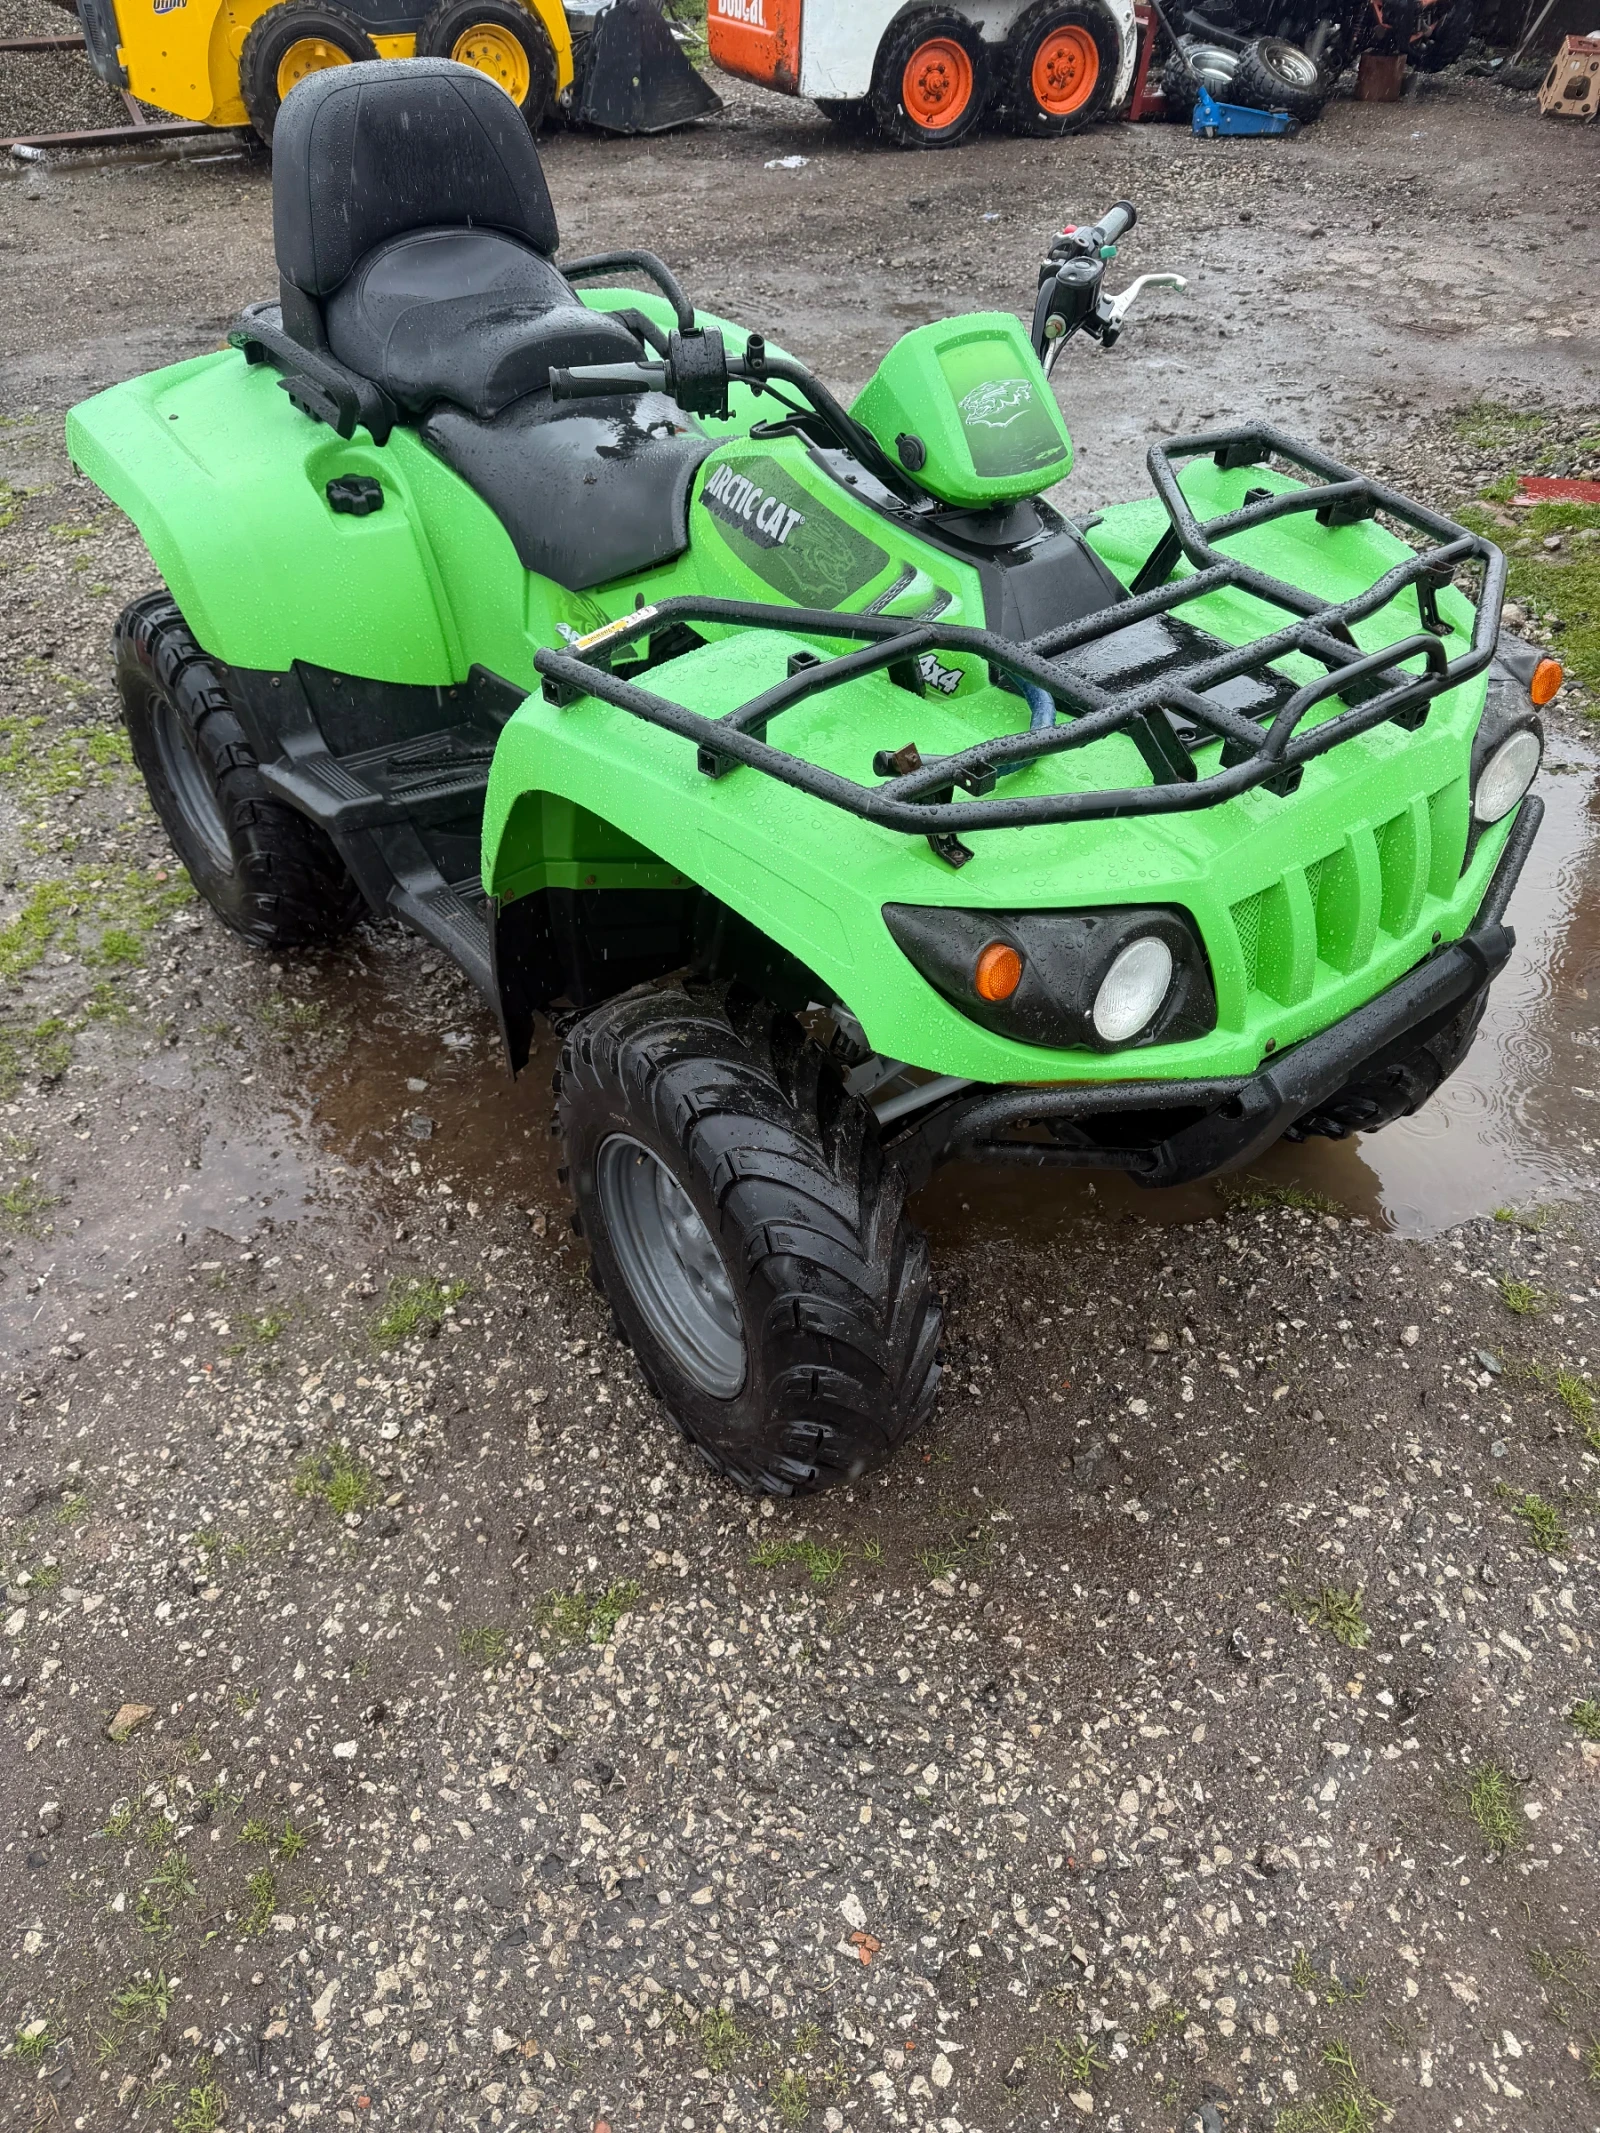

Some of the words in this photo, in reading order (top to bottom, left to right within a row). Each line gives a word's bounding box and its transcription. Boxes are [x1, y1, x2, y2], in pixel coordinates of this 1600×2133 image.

[704, 463, 764, 520] ARCTIC
[756, 496, 802, 544] CAT
[918, 654, 964, 693] 4x4
